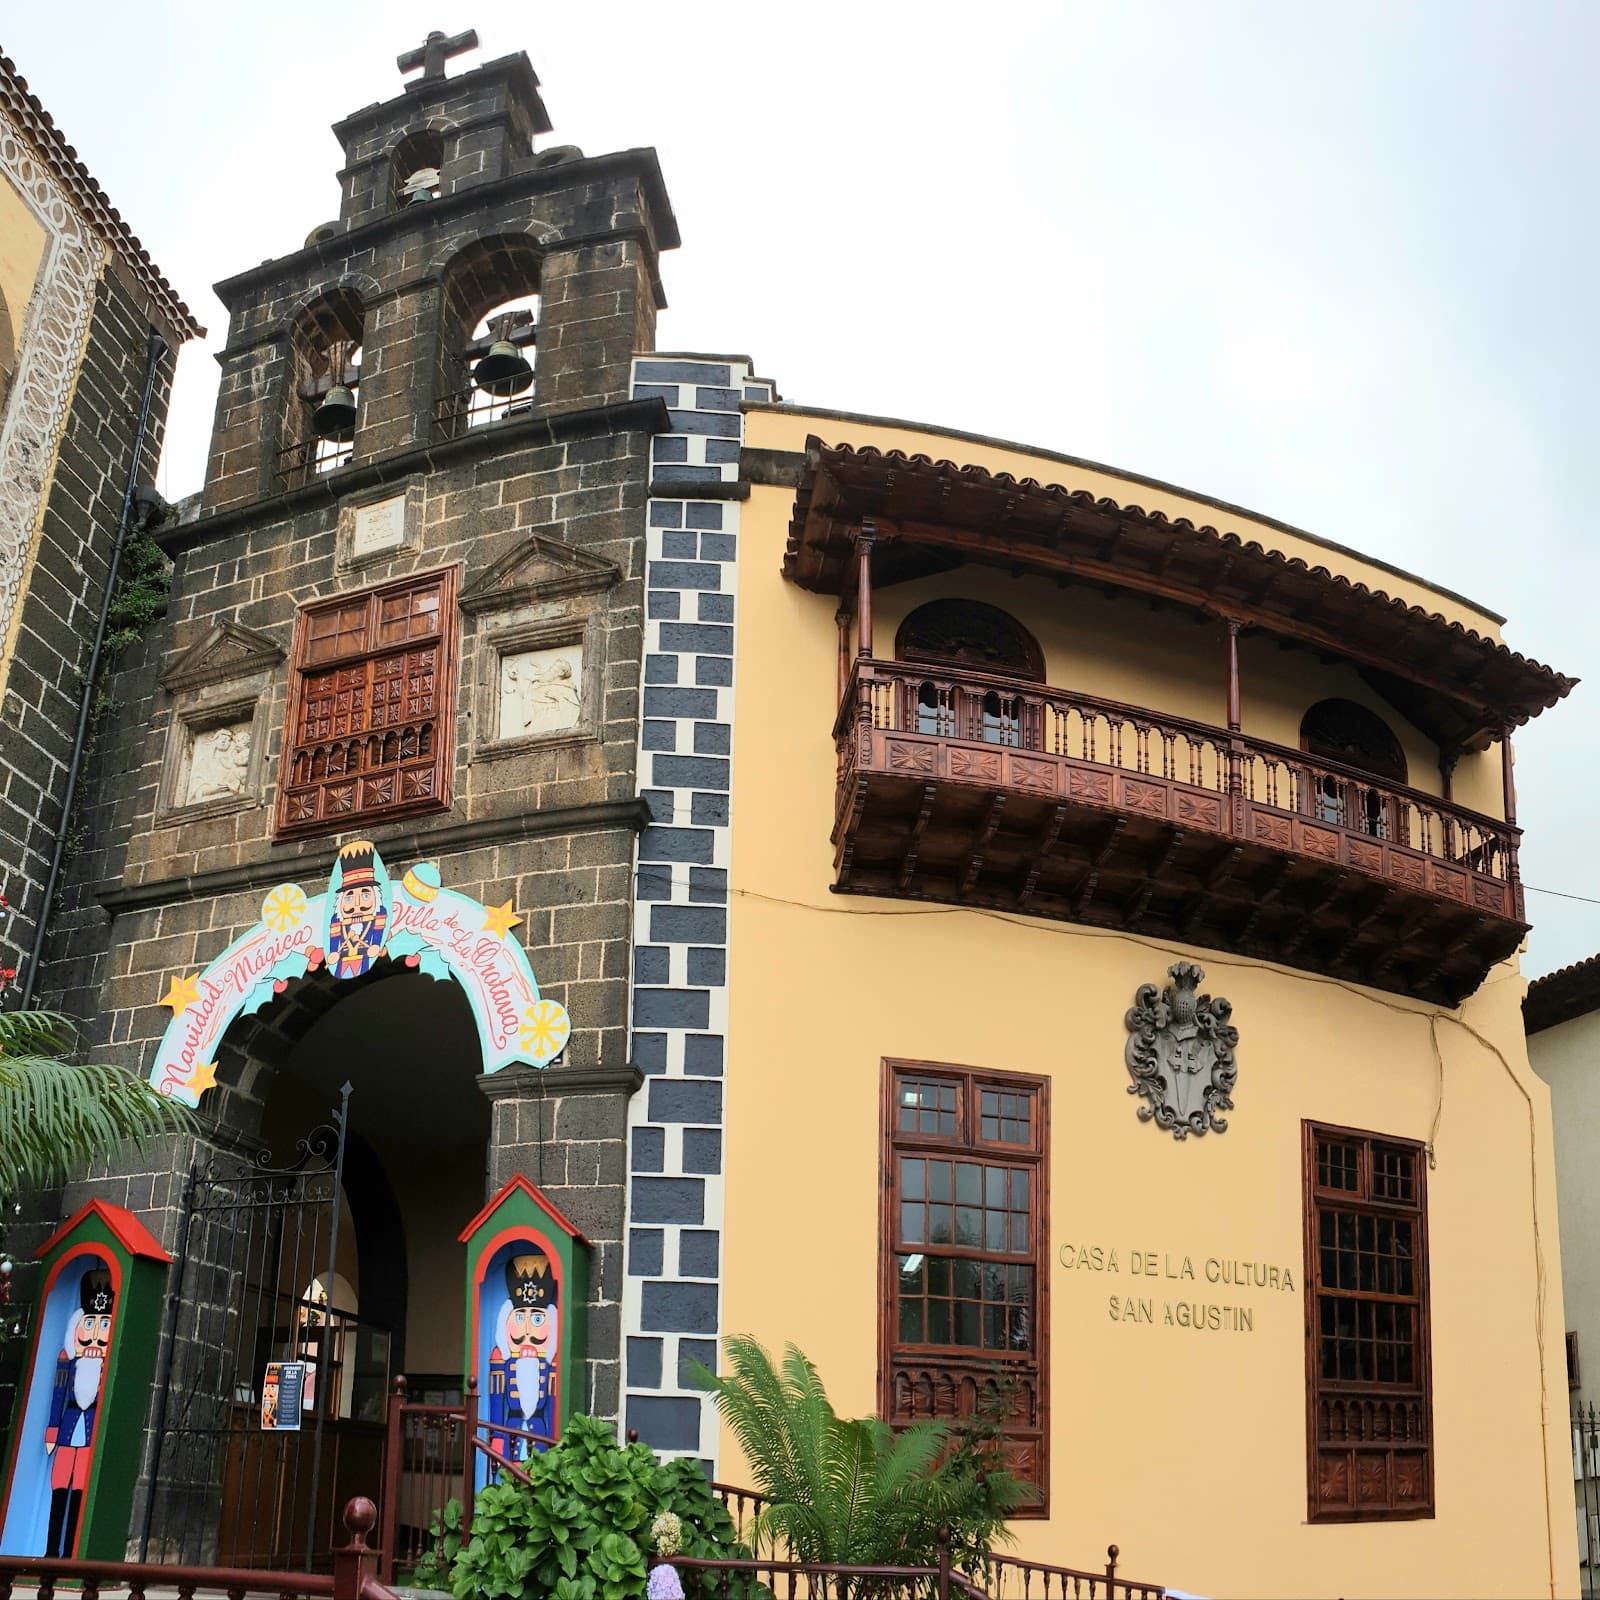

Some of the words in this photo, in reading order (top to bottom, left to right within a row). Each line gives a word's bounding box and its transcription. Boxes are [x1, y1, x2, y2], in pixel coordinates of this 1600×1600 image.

[389, 901, 443, 932] Villa
[442, 910, 459, 929] de
[448, 928, 474, 960] La
[471, 937, 519, 1036] Orotava
[159, 979, 224, 1097] Navidad
[223, 925, 313, 993] Mágica
[1059, 1242, 1119, 1273] CASA
[1130, 1249, 1159, 1277] DE
[1165, 1253, 1195, 1281] LA
[1205, 1257, 1296, 1293] CULTURA
[1108, 1294, 1153, 1324] SAN
[1163, 1299, 1254, 1332] AGUSTIN
